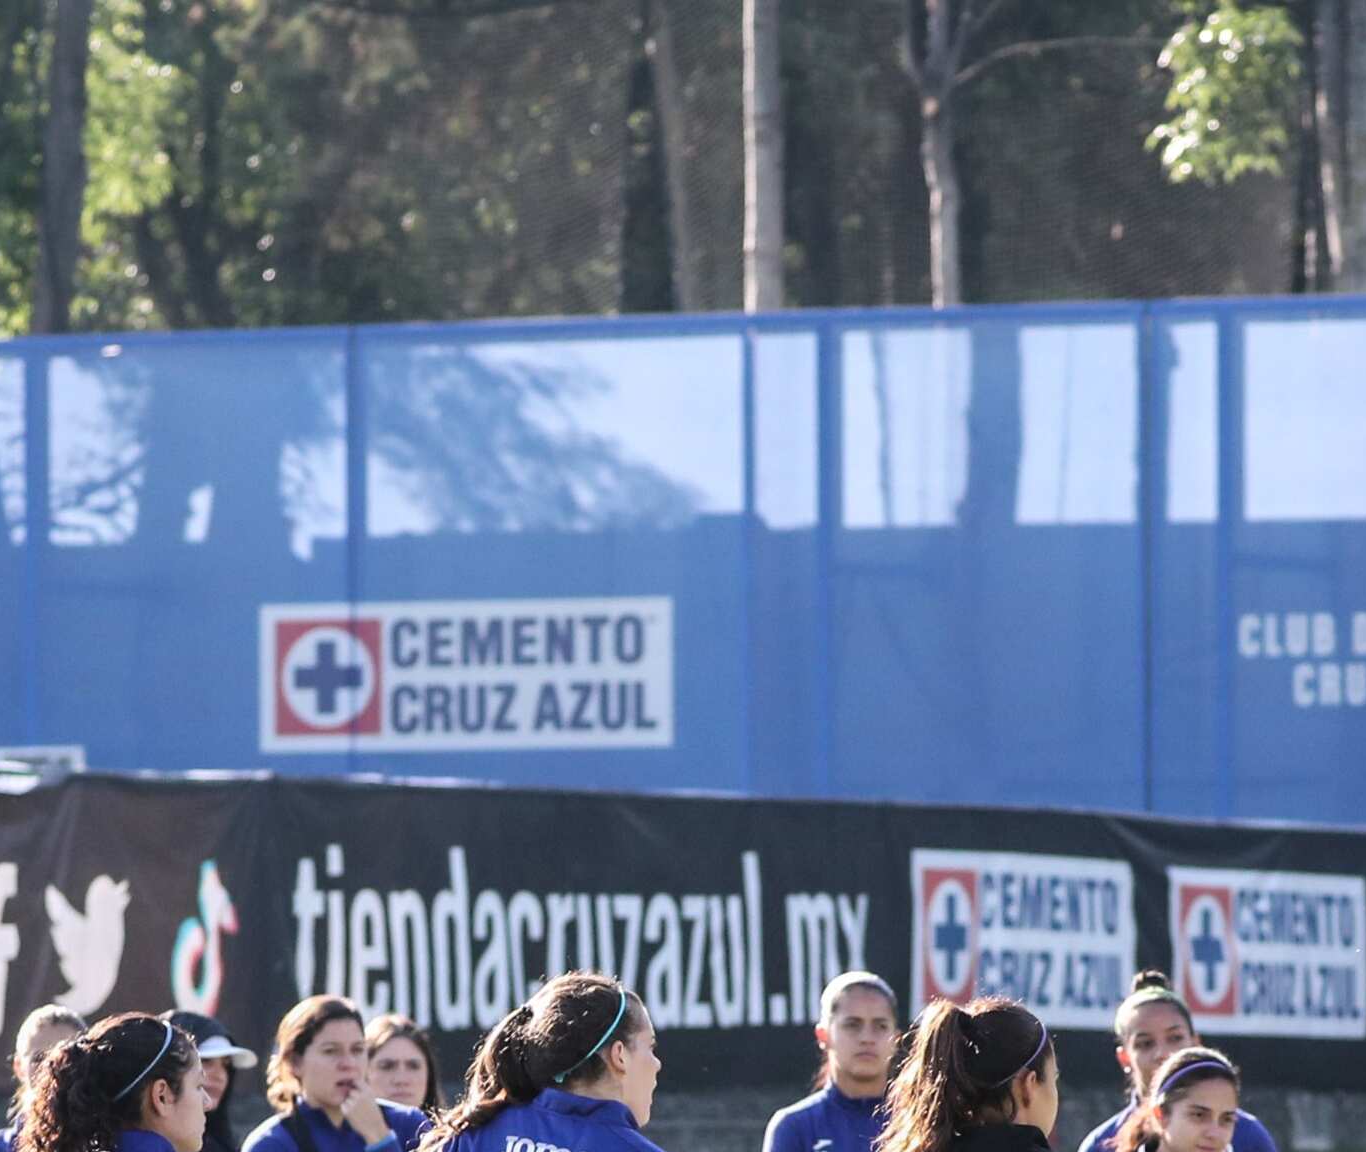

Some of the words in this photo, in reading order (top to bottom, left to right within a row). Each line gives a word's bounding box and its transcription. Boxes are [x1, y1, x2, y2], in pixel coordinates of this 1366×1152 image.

[390, 614, 645, 669] CEMENTO
[1237, 612, 1336, 660] CLUB
[390, 681, 519, 735] CRUZ
[533, 681, 657, 731] AZUL
[980, 871, 1119, 933] CEMENTO
[1234, 888, 1356, 948] CEMENTO
[292, 843, 869, 1028] tiendacruzazul.mx
[980, 948, 1053, 1005] CRUZ
[1062, 949, 1123, 1009] AZUL
[1237, 961, 1296, 1015] CRUZ
[1302, 966, 1361, 1019] AZUL
